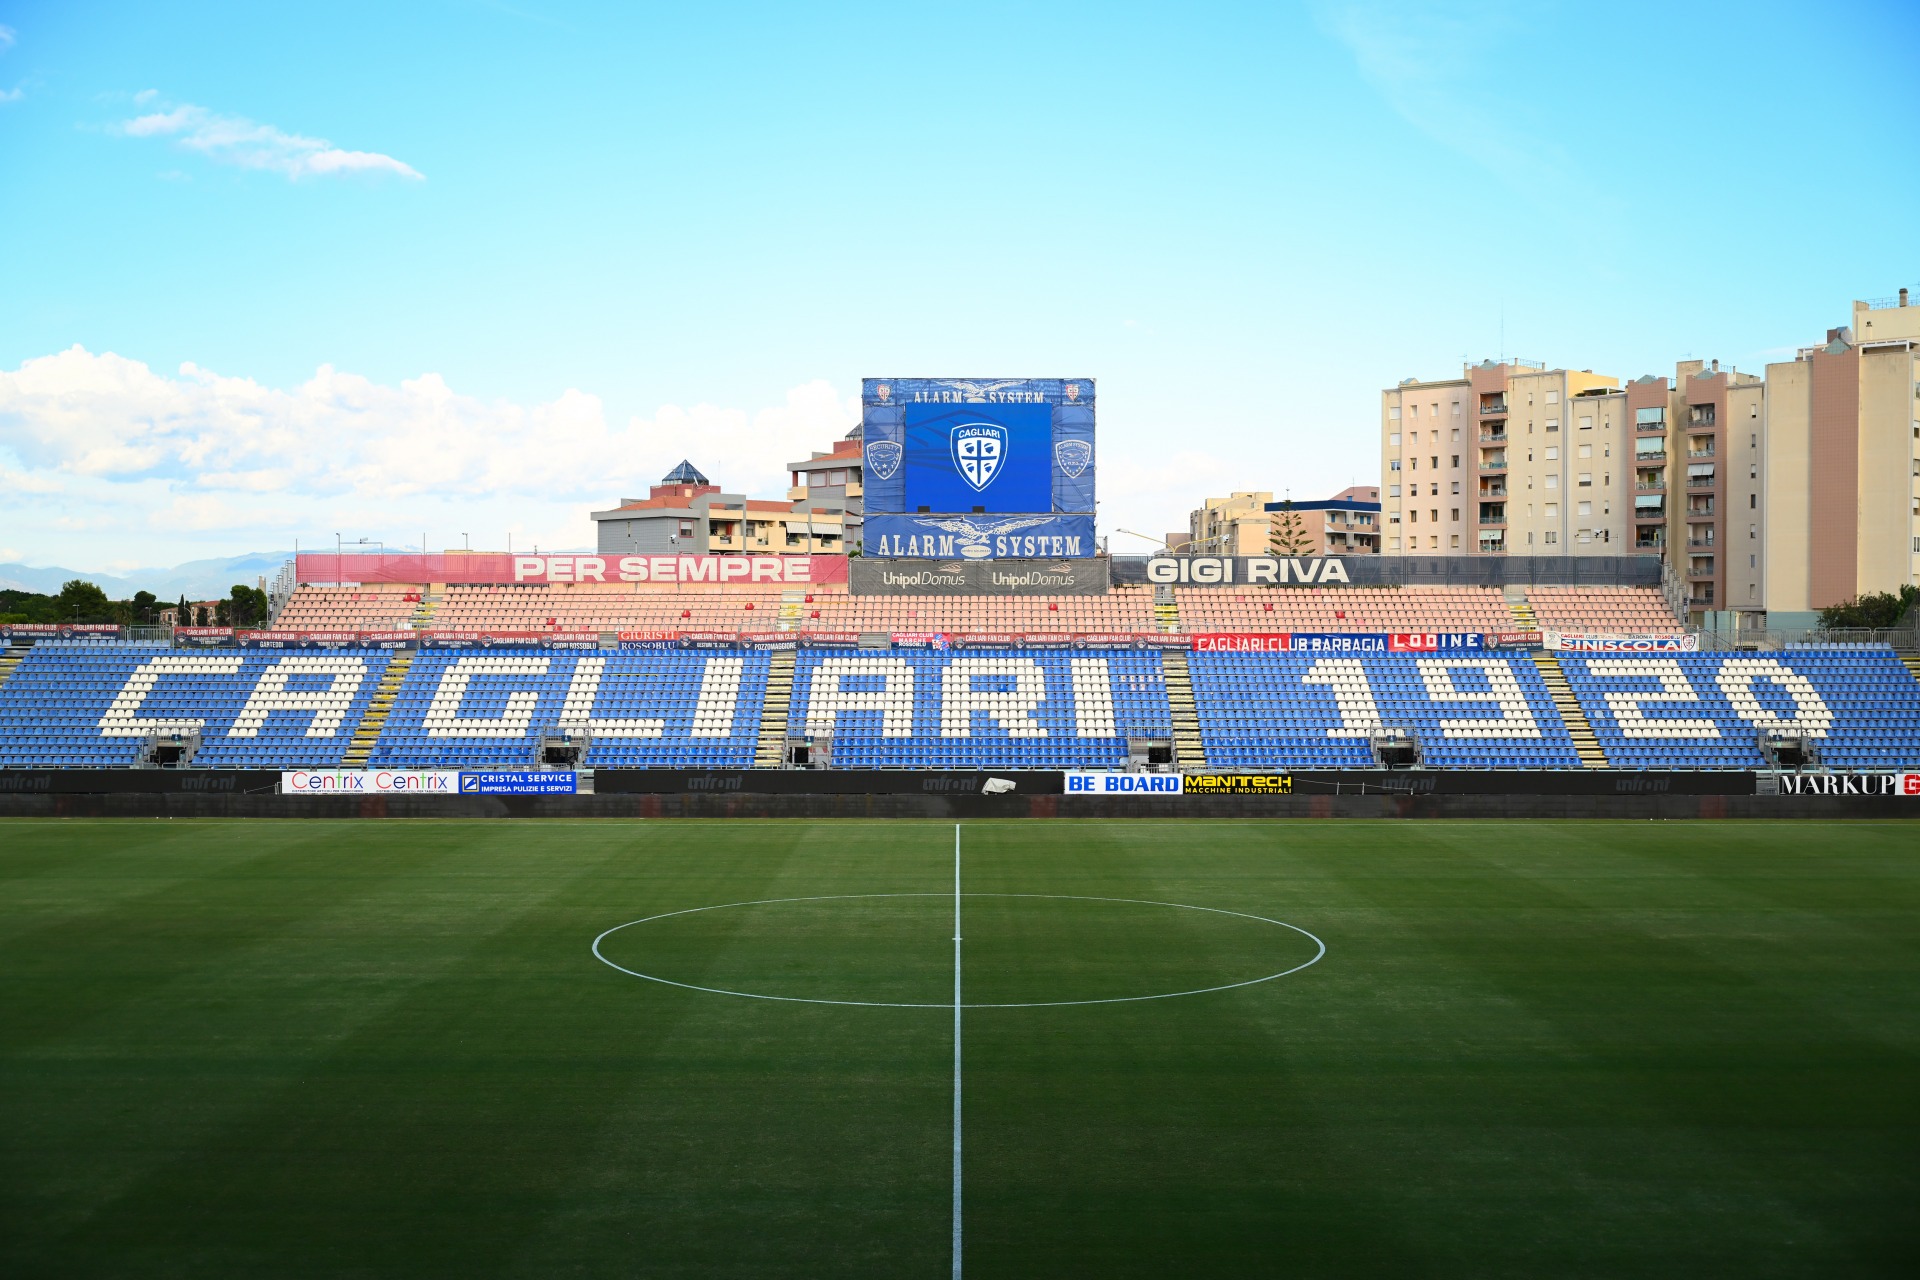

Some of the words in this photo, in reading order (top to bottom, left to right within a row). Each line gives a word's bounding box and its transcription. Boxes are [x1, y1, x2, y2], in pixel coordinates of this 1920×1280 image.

[914, 392, 962, 403] ALARM
[990, 392, 1044, 403] SYSTEM
[958, 428, 1000, 438] CAGLIARI
[878, 535, 954, 556] ALARM
[996, 536, 1081, 556] SYSTEM
[514, 557, 606, 582] PER
[619, 557, 811, 582] SEMPRE
[1147, 558, 1232, 583] GIGI
[1248, 558, 1350, 583] RIVA
[883, 571, 965, 589] UnipolDomus
[992, 572, 1074, 589] UnipolDomus
[620, 632, 674, 640] GIURISTI
[1198, 638, 1264, 651] CAGLIARI
[1268, 638, 1307, 651] CLUB
[1312, 638, 1384, 651] BARBAGIA
[1394, 634, 1478, 647] LODINE
[1561, 639, 1679, 650] SINISCOLA
[755, 642, 796, 650] POZZOMAGGIORE
[97, 656, 1116, 738] CAGLIARI
[1301, 658, 1834, 738] 1920
[292, 772, 364, 789] Centrix
[376, 772, 447, 789] Centrix
[1068, 776, 1095, 791] BE
[1105, 776, 1179, 791] BOARD
[1780, 775, 1895, 794] MARKUP
